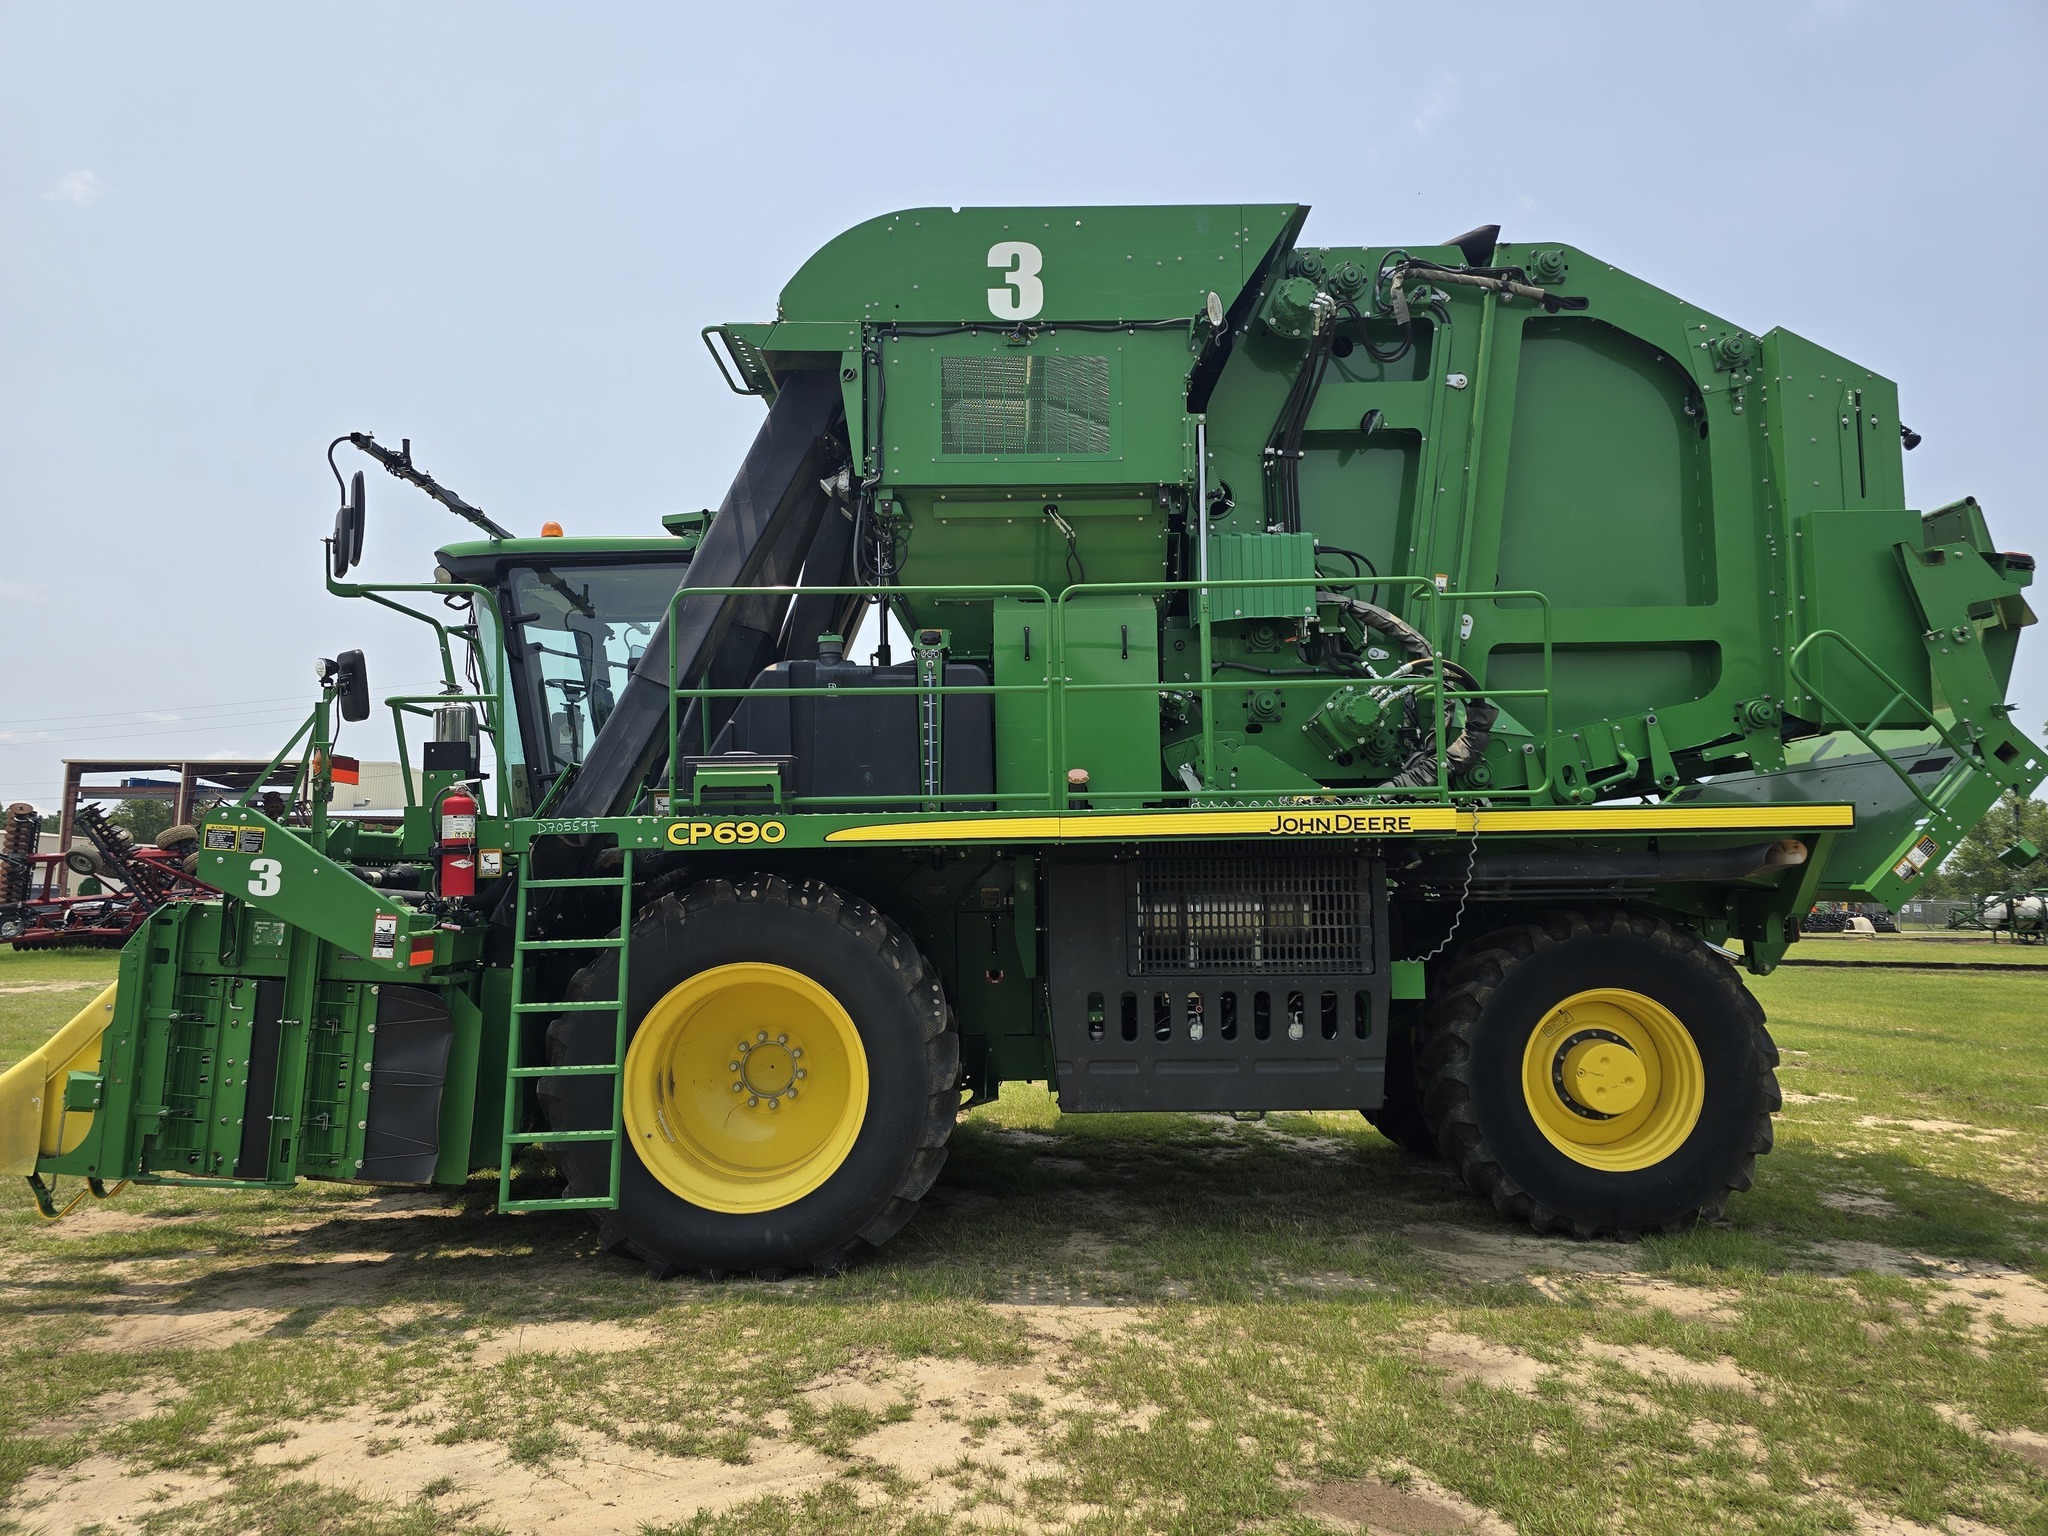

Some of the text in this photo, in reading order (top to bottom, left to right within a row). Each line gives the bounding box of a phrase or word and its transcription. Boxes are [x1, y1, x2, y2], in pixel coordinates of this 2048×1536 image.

[987, 241, 1044, 321] 3
[537, 821, 600, 834] D705597
[667, 820, 787, 846] CP690
[1270, 814, 1412, 833] JOHN DEERE
[248, 858, 282, 897] 3
